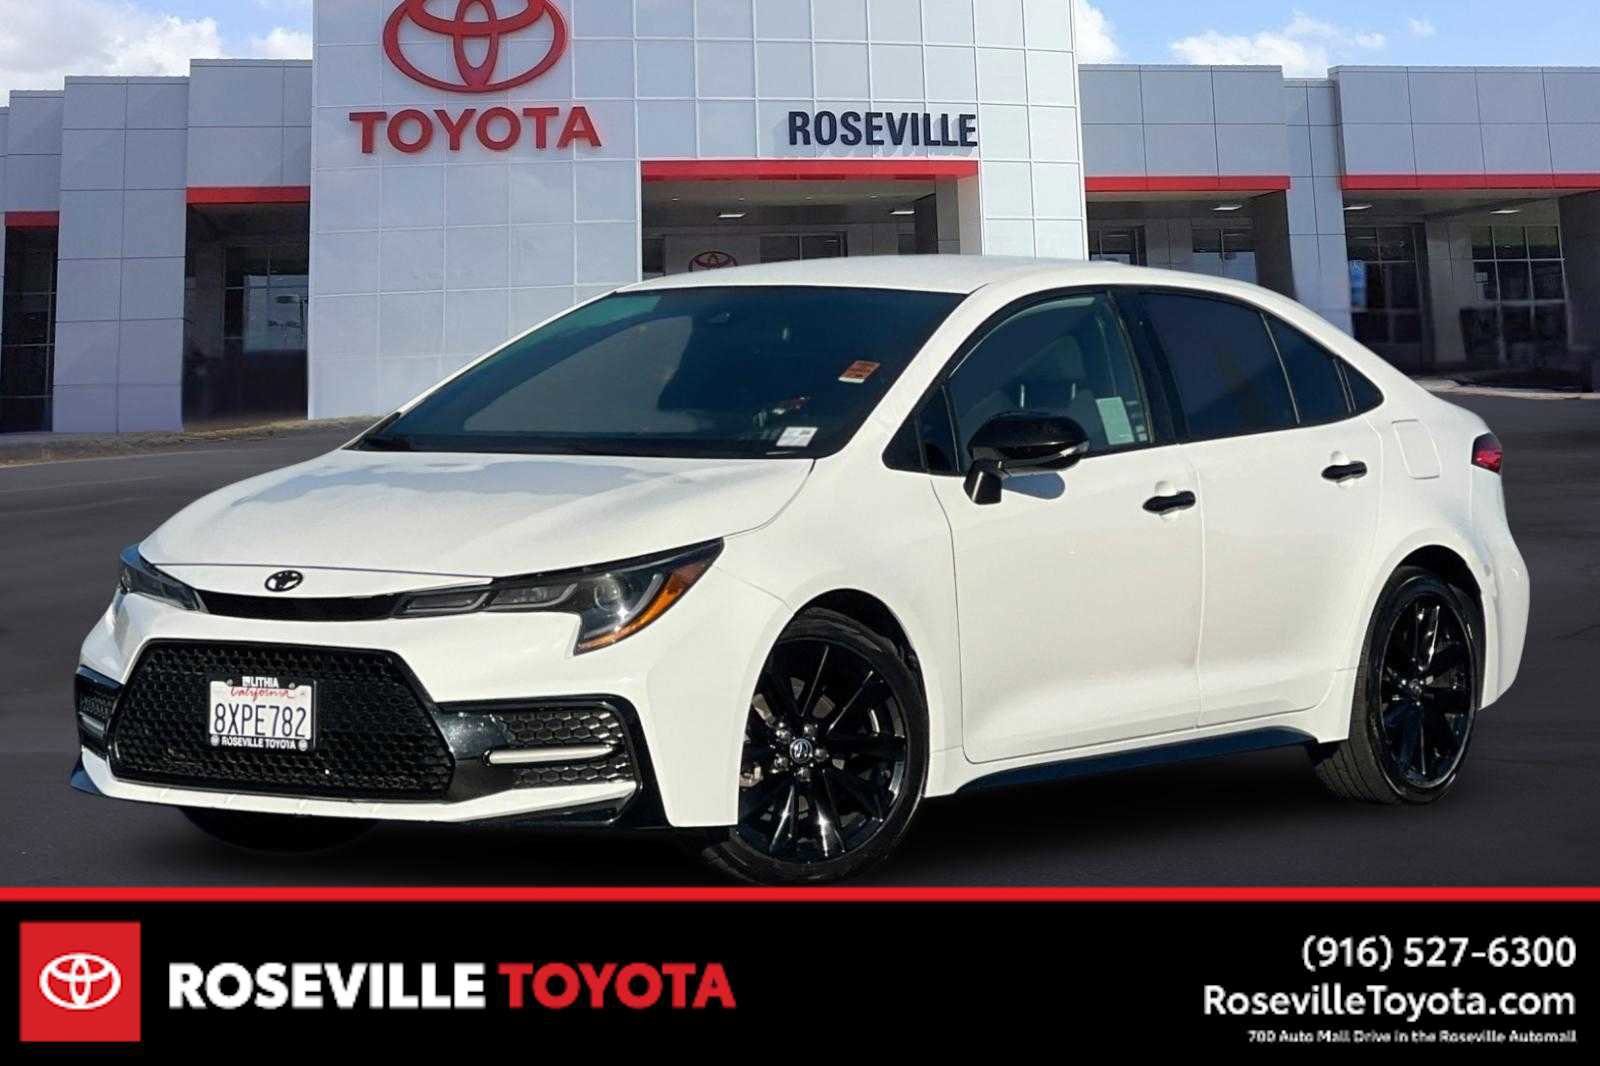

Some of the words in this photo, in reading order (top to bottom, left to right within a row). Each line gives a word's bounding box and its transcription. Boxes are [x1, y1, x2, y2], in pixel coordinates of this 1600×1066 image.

[349, 105, 602, 154] TOYOTA
[789, 110, 978, 147] ROSEVILLE
[214, 702, 307, 738] 8XPE782
[221, 736, 264, 749] ROSEVILLE
[265, 739, 296, 750] TOYOTA
